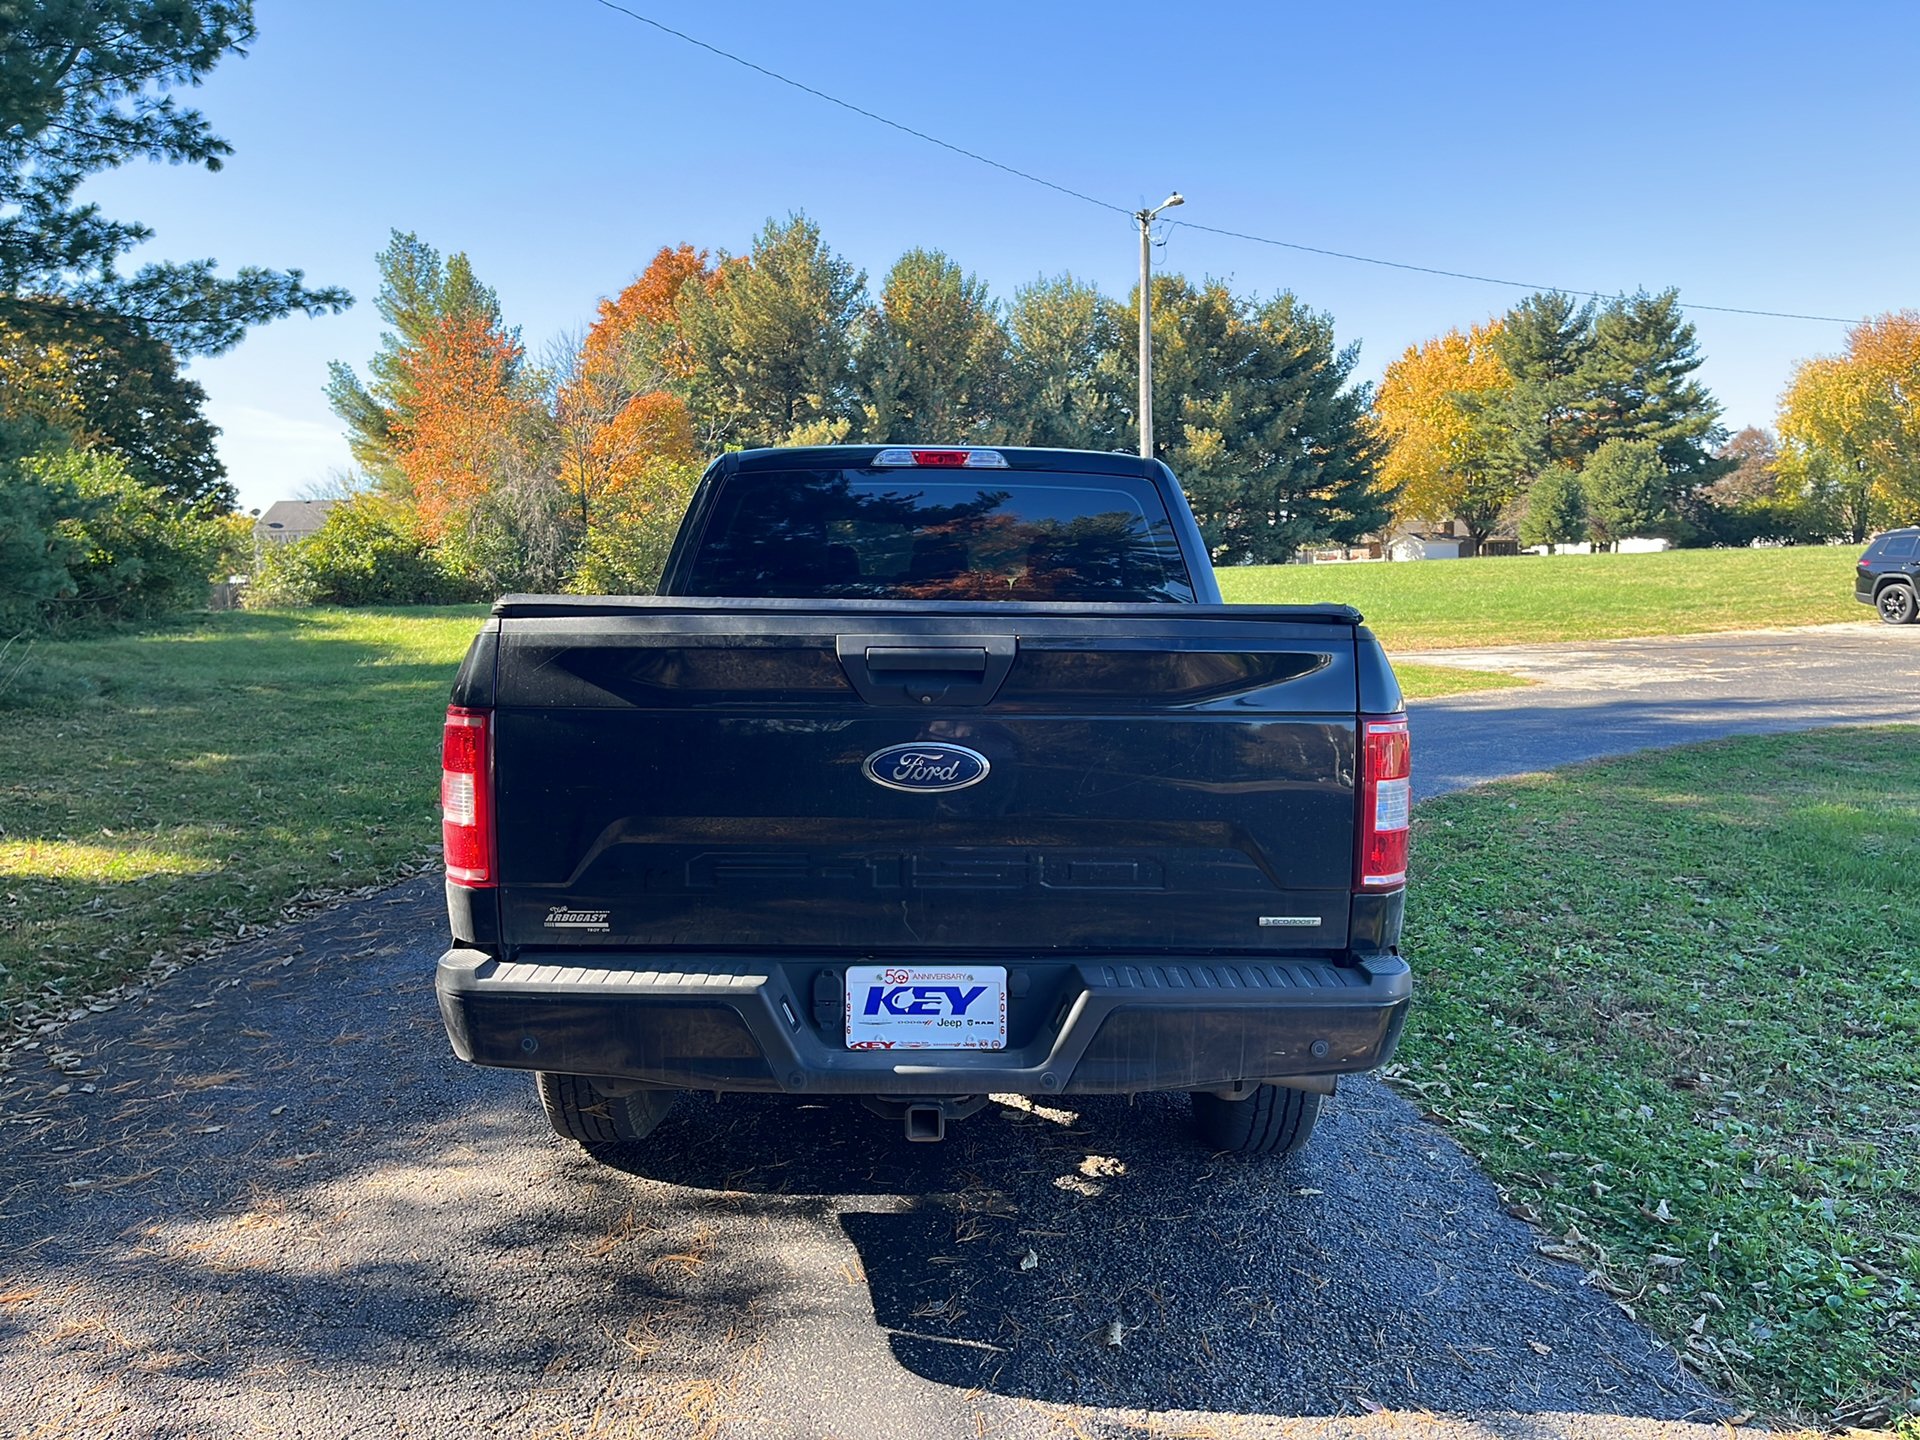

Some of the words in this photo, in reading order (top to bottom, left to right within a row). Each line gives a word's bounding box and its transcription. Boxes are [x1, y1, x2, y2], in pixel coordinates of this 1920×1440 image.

[893, 753, 960, 780] Ford
[545, 914, 607, 922] ARBOGAST
[864, 986, 988, 1015] KEY
[937, 1018, 962, 1028] Jeep
[850, 1041, 896, 1049] KEY
